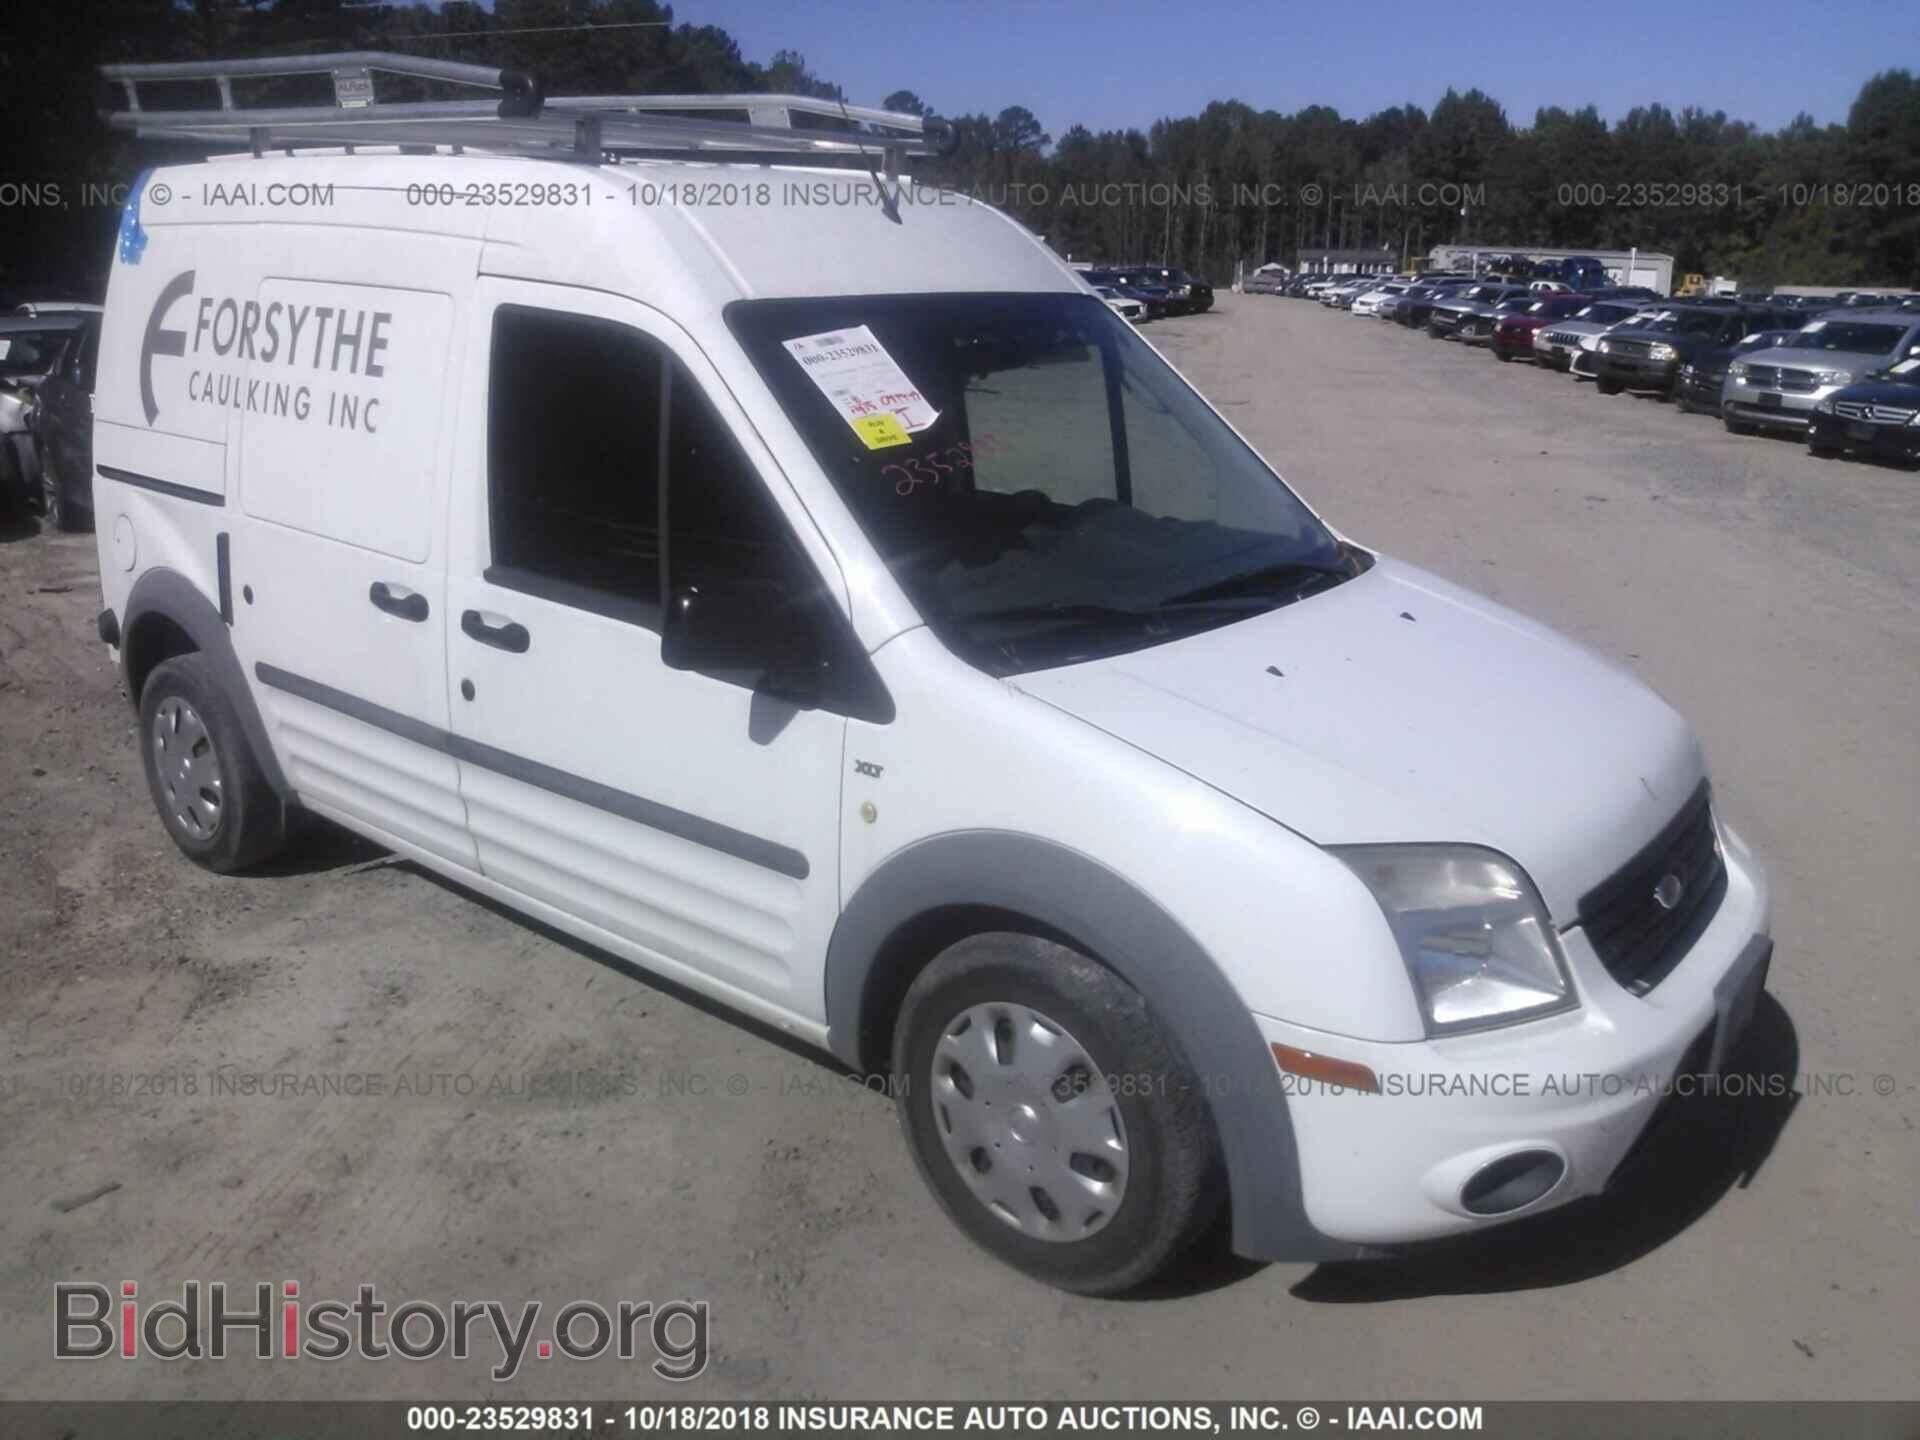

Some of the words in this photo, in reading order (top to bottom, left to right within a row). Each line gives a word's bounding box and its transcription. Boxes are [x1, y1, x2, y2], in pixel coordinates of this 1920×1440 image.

[193, 297, 393, 378] FORSYTHE
[188, 370, 312, 421] CAULKING
[328, 391, 380, 433] INC
[854, 759, 884, 779] XLT
